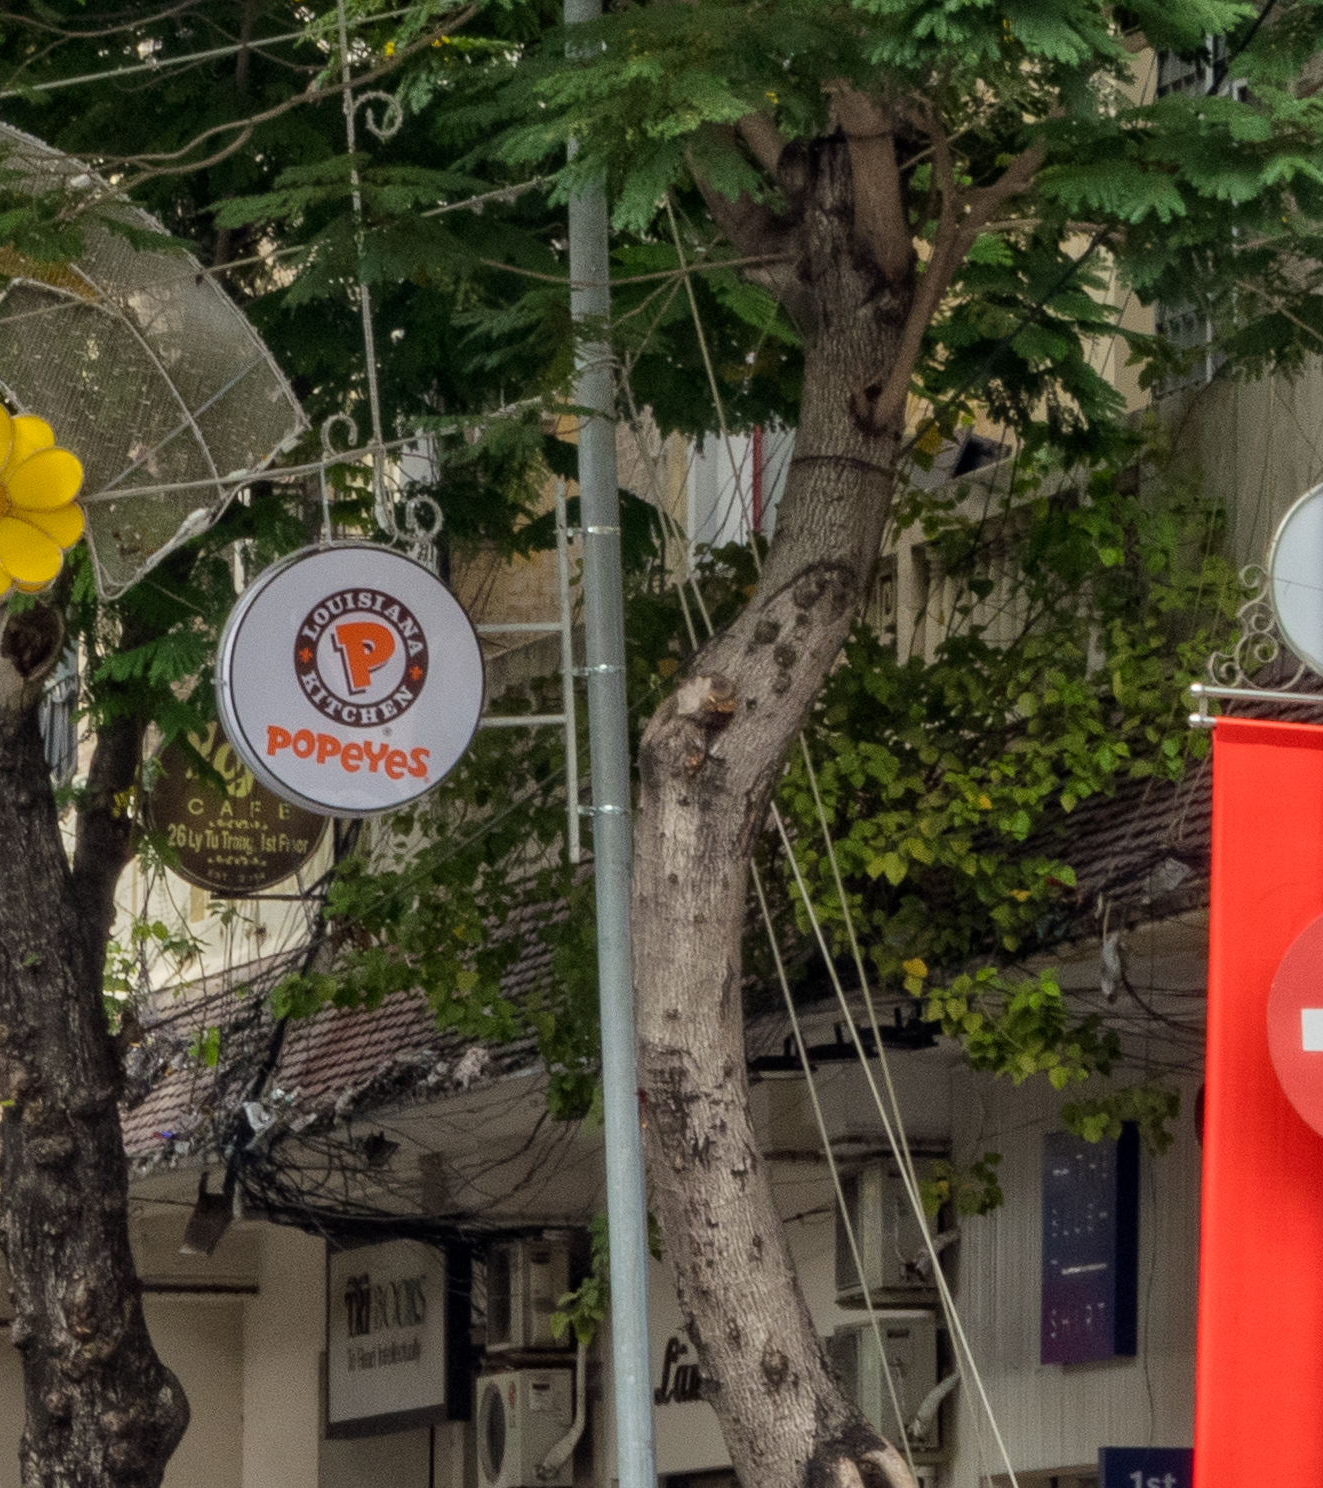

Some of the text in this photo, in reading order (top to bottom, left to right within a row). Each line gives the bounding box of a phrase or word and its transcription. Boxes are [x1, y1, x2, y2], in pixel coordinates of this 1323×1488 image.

[302, 591, 423, 656] LOUISIANA
[331, 621, 395, 696] P
[302, 672, 413, 725] KITCHEN
[188, 799, 290, 820] CAFE
[168, 823, 187, 847] 26
[189, 830, 203, 853] Ly
[205, 829, 219, 849] Tu
